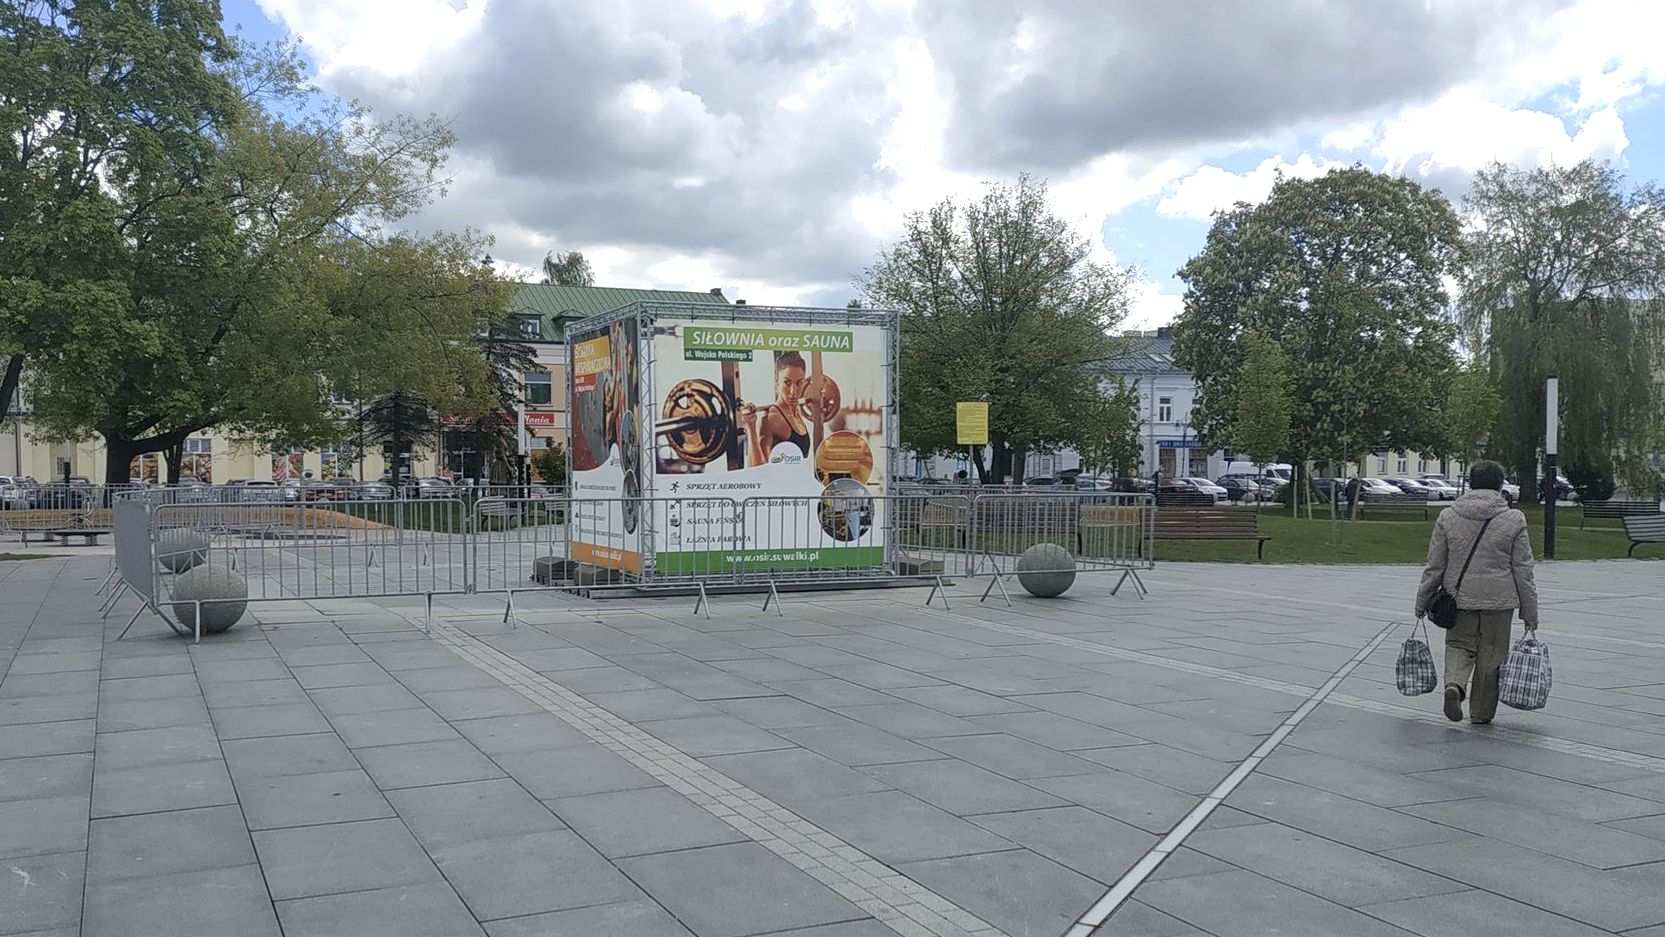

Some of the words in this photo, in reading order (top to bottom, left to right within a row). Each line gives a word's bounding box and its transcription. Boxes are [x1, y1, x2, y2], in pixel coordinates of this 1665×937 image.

[692, 331, 764, 346] SIŁOWNIA
[768, 336, 799, 347] oraz
[803, 334, 850, 349] SAUNA
[717, 482, 763, 490] AEROBOWY
